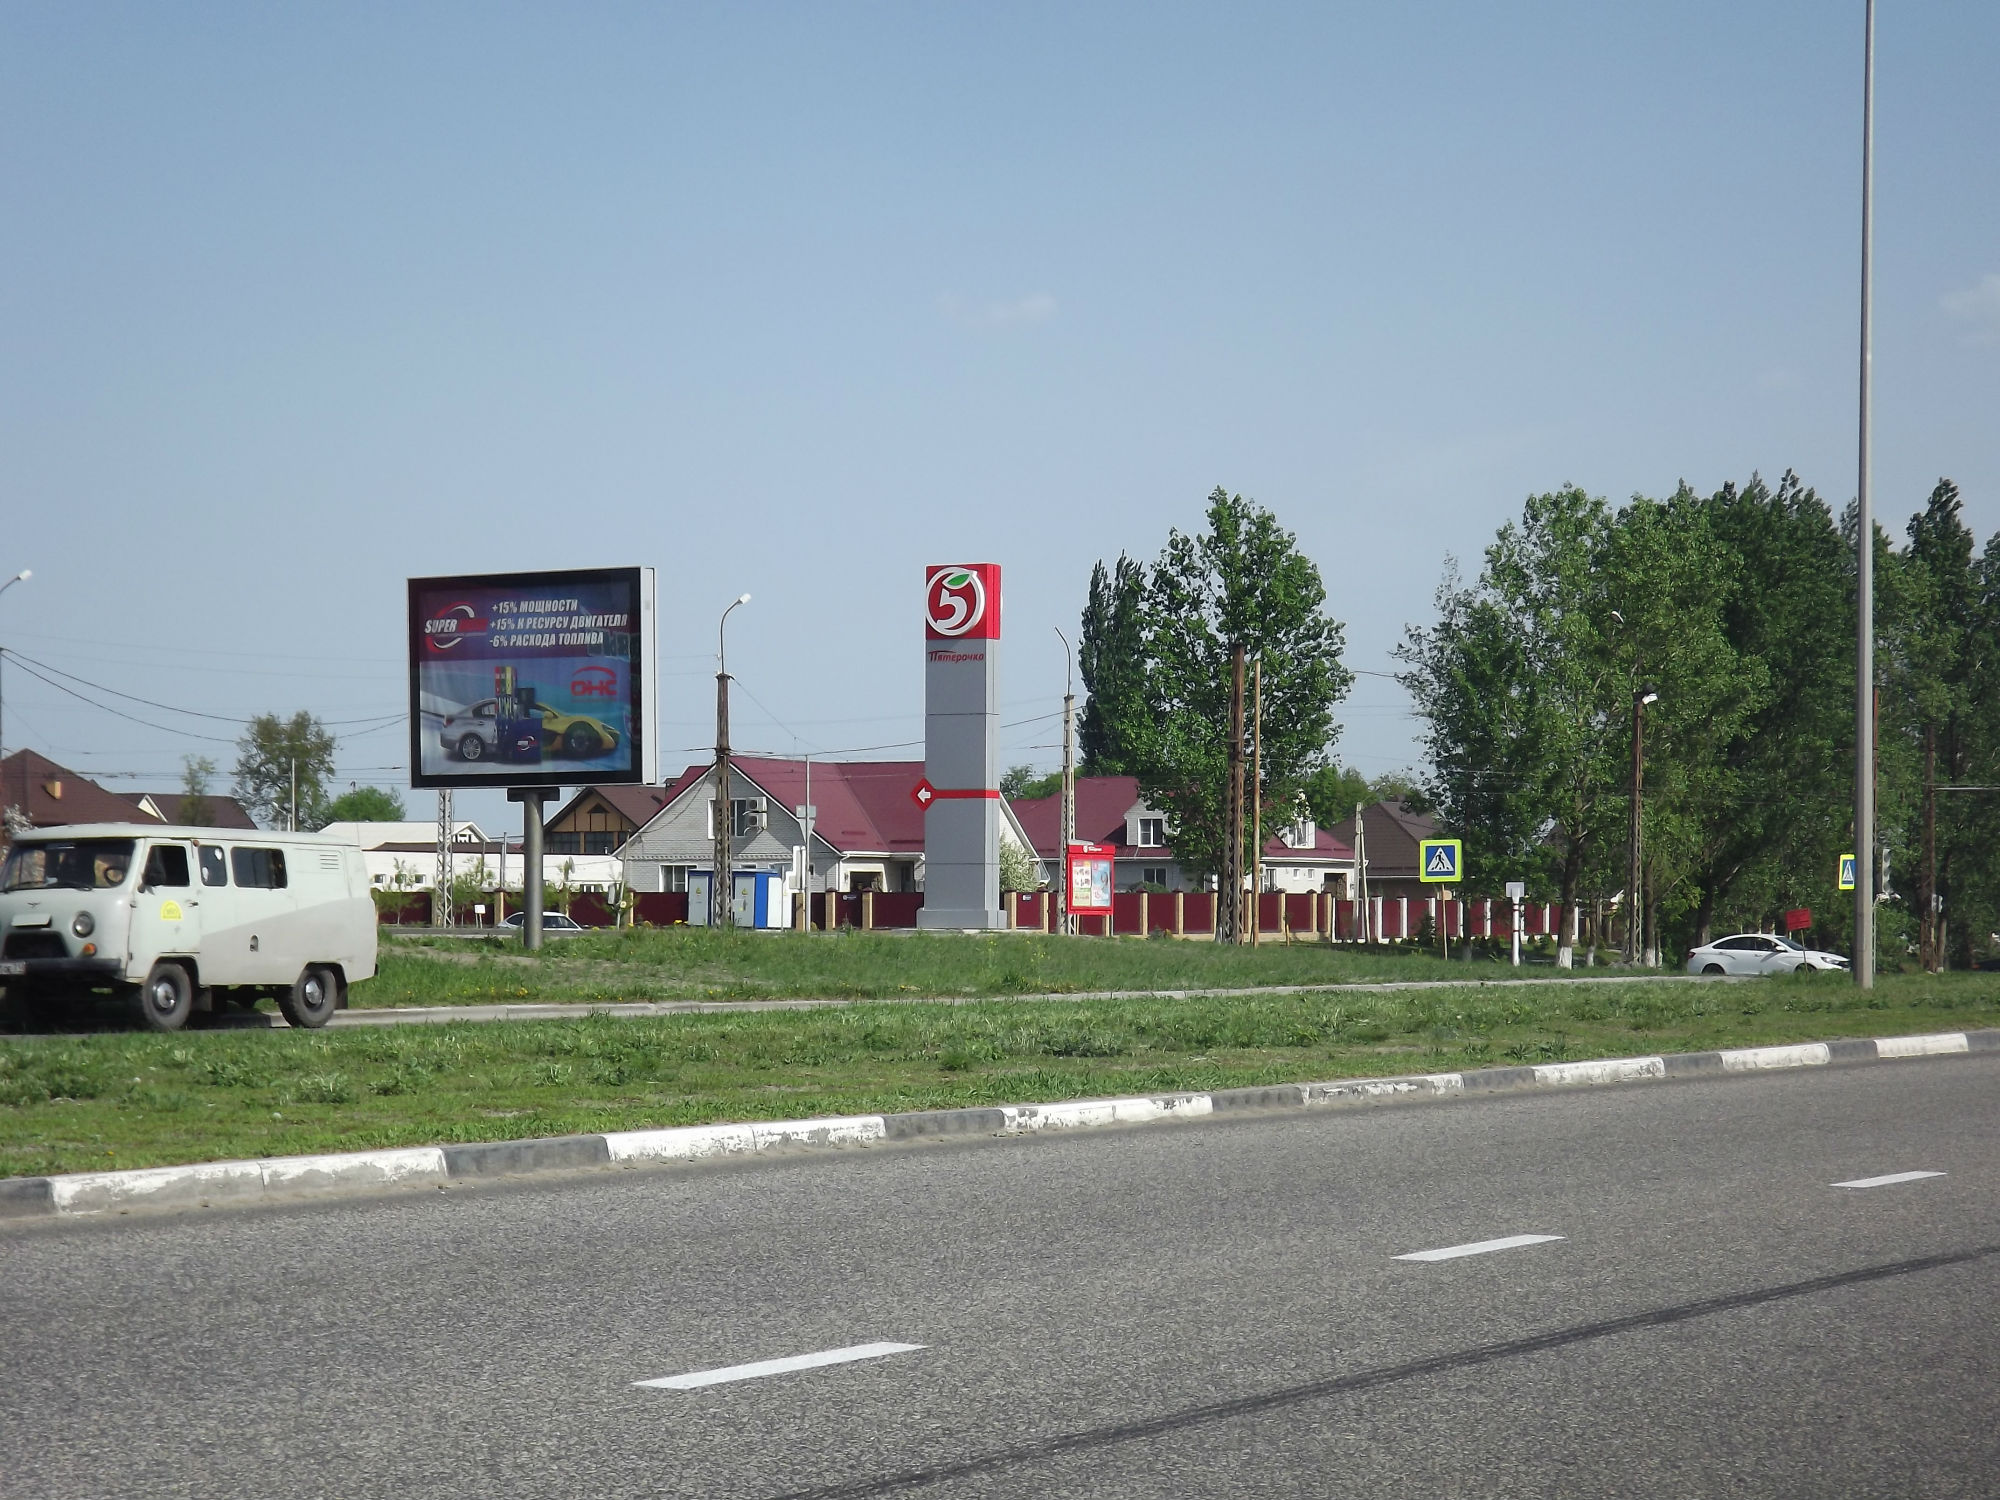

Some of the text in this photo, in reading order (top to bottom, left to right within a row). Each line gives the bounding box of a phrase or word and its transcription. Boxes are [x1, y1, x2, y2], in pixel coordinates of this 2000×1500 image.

[492, 599, 578, 614] +15% МОЩНОСТИ
[936, 588, 968, 629] 5
[424, 619, 458, 634] SUPER
[490, 617, 515, 631] +15%
[517, 617, 526, 629] К
[526, 616, 571, 630] РЕСУРСУ
[569, 614, 628, 630] ДВИГАТЕЛЯ
[489, 631, 604, 648] -6% РАСХОДА ТОПЛИВА
[928, 649, 985, 663] Пятерочка
